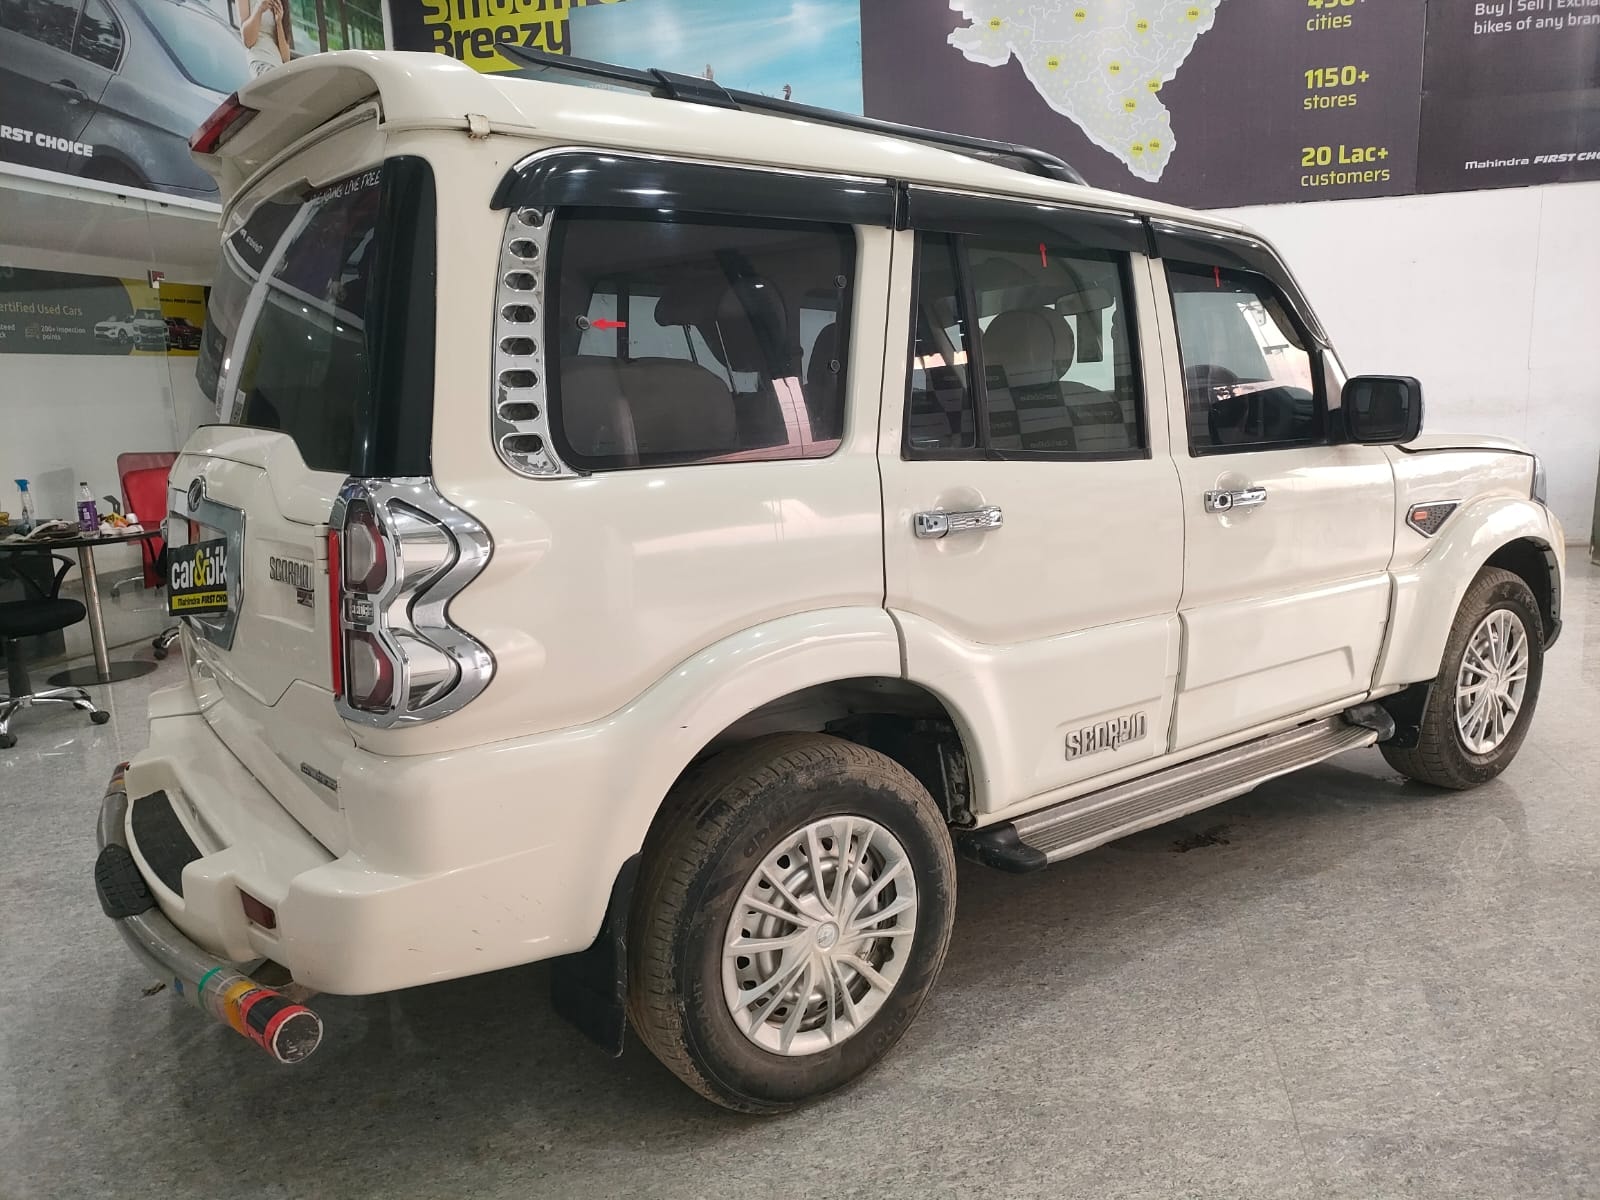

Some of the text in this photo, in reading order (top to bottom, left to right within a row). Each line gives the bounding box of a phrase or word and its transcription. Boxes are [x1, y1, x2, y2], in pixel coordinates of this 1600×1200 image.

[1475, 3, 1504, 17] Buy
[1517, 0, 1544, 12] Sell
[1306, 12, 1352, 31] cities
[1474, 20, 1512, 34] bikes
[1516, 16, 1532, 31] of
[1535, 16, 1564, 30] any
[424, 19, 571, 60] Breezy
[1304, 65, 1370, 89] 1150+
[1303, 94, 1357, 110] stores
[35, 132, 93, 157] CHOICE
[1301, 144, 1389, 167] 20 Lac+
[1464, 158, 1530, 170] Mahindra
[1533, 153, 1577, 164] FIRST
[1301, 169, 1390, 187] customers
[37, 303, 61, 315] Used
[62, 305, 83, 317] Cars
[269, 556, 315, 590] SCORPIO
[1065, 711, 1147, 761] SCORPIO
